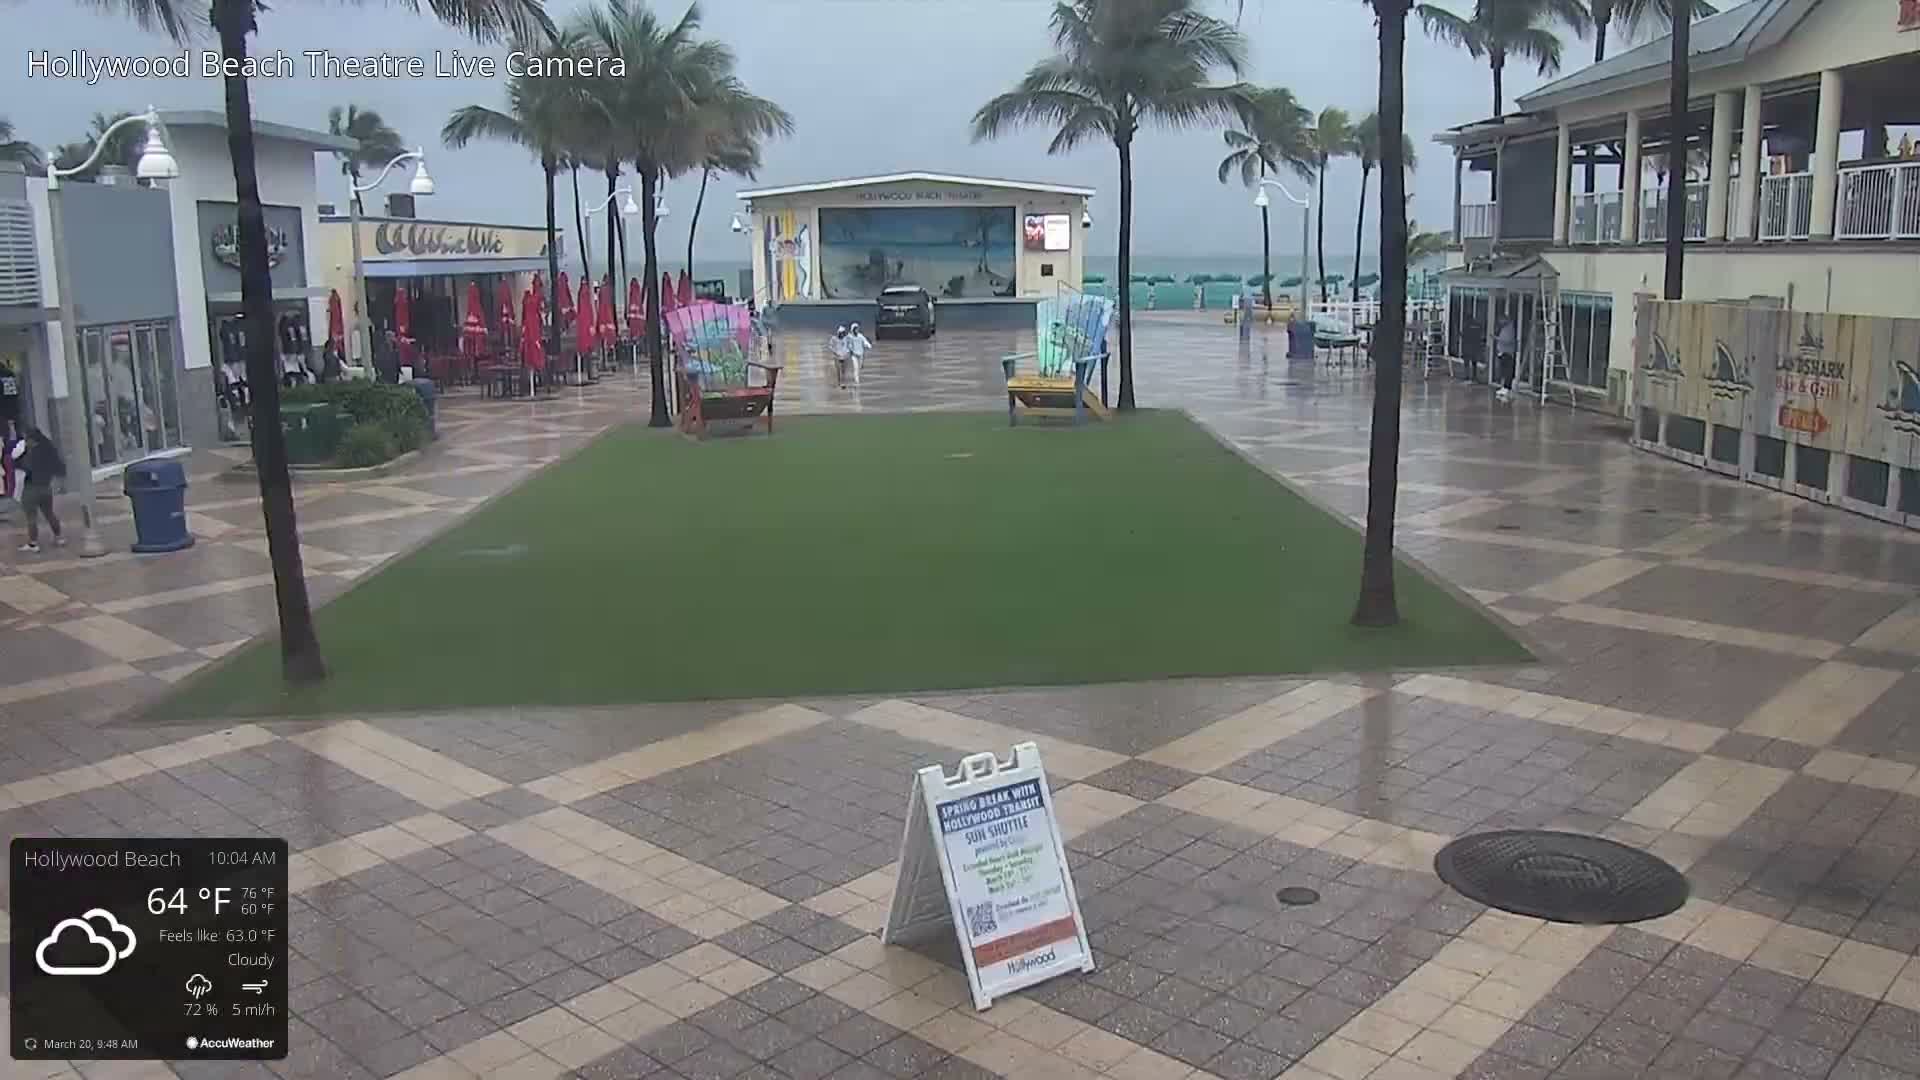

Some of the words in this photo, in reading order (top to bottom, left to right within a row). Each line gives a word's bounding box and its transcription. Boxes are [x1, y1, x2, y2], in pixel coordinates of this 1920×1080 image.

[942, 799, 978, 819] SPRING
[979, 790, 1011, 809] BREAK
[1011, 782, 1037, 800] WITH
[943, 807, 1002, 833] HOLLYWOOD
[1003, 795, 1041, 816] TRANSIT
[964, 829, 987, 846] SUN
[988, 815, 1029, 839] SHUTTLE
